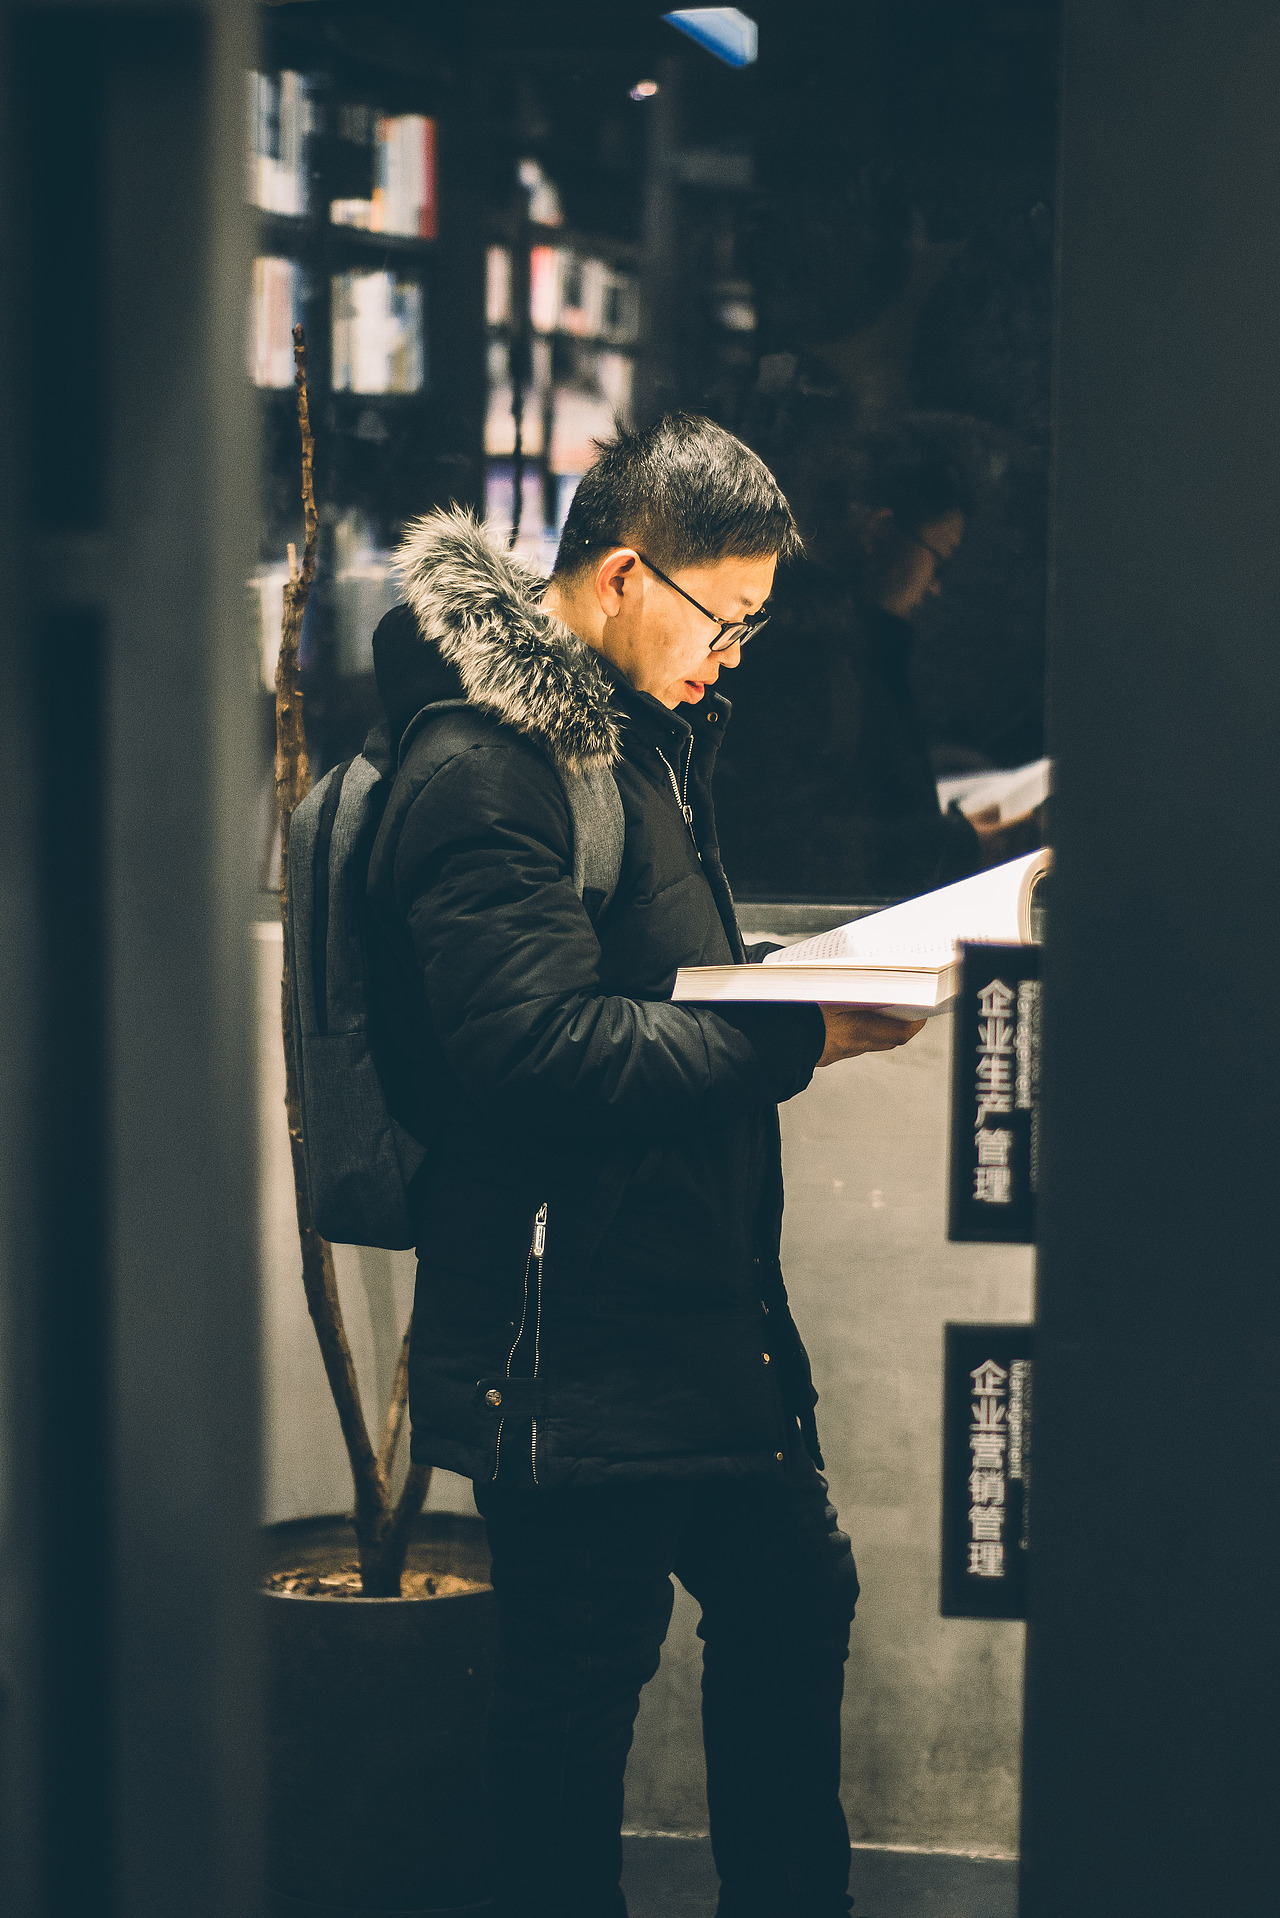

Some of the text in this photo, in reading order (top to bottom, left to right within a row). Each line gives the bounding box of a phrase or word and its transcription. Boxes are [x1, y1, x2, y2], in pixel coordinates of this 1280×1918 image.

[974, 978, 1014, 1203] 企业生产管理
[967, 1359, 1007, 1576] 企业营销管理
